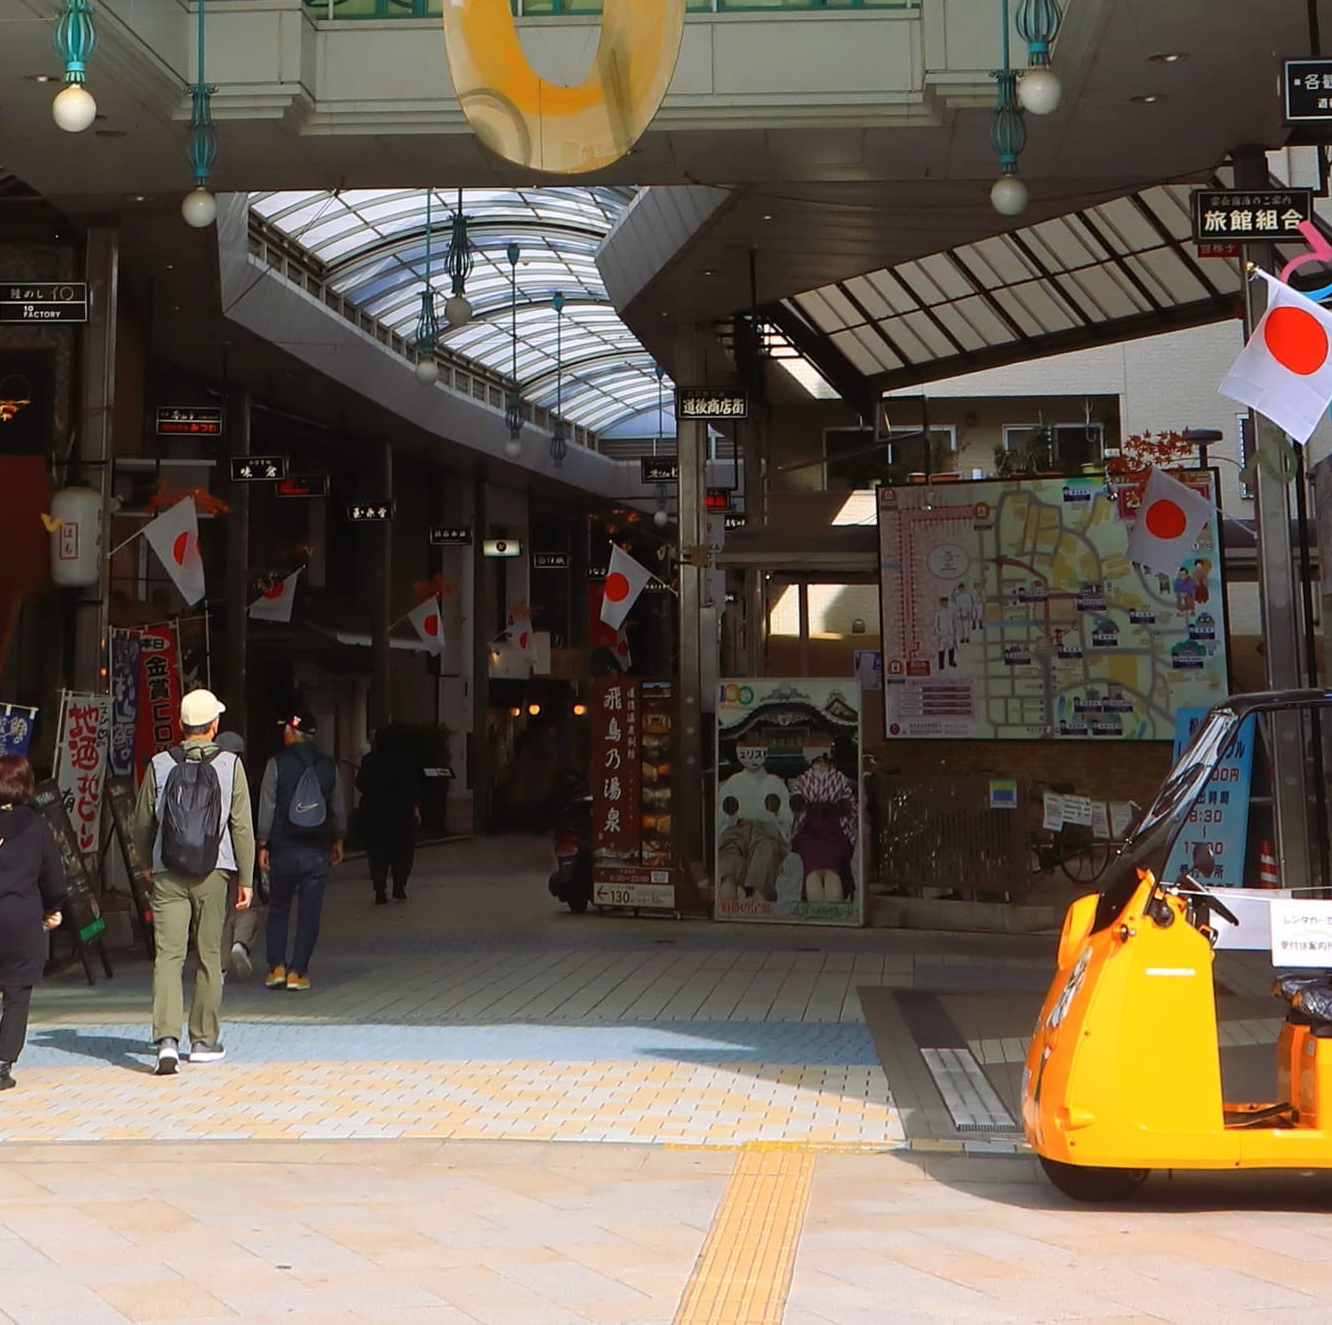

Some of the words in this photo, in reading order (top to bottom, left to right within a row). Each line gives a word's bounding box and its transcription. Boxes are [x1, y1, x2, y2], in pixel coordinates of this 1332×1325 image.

[1204, 209, 1305, 232] 旅館組合
[23, 311, 62, 319] FACTORY
[682, 397, 745, 415] 道後商店街
[603, 685, 622, 832] 飛鳥乃湯泉
[1209, 768, 1238, 782] 00円
[1195, 790, 1230, 805] 出時間
[1188, 809, 1222, 823] 8:30
[1179, 863, 1224, 880] 受付所
